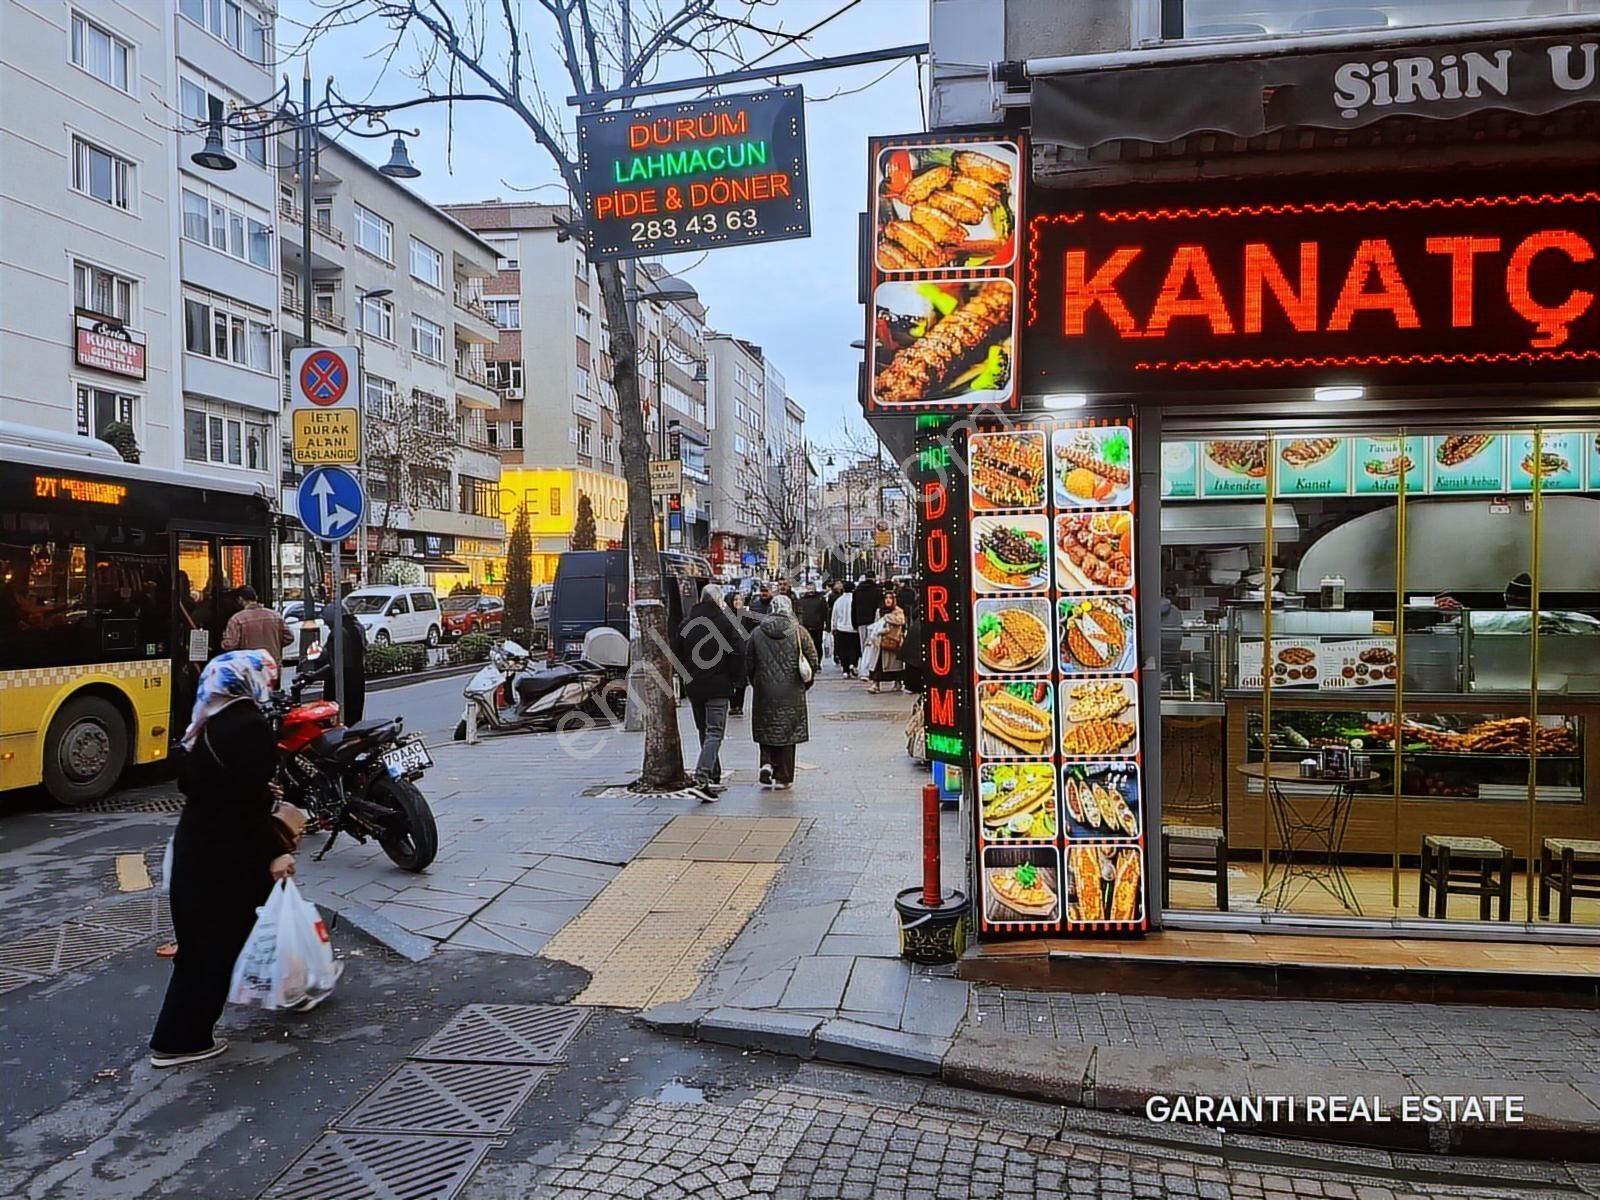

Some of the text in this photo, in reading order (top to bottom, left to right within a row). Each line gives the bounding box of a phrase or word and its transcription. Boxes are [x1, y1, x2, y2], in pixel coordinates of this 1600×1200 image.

[629, 111, 748, 149] DÜRÜM
[614, 141, 767, 183] LAHMACUN
[596, 174, 791, 220] PİDE & DÖNER
[630, 208, 758, 242] 283 43 63
[1062, 229, 1597, 348] KANATÇ
[303, 425, 349, 435] DURAK
[311, 412, 342, 423] İETT
[297, 449, 356, 461] BAŞLANGICI
[307, 438, 347, 448] ALANI
[1296, 477, 1331, 490] Kanat
[925, 481, 954, 727] DÜRÜM
[400, 743, 422, 760] AAC
